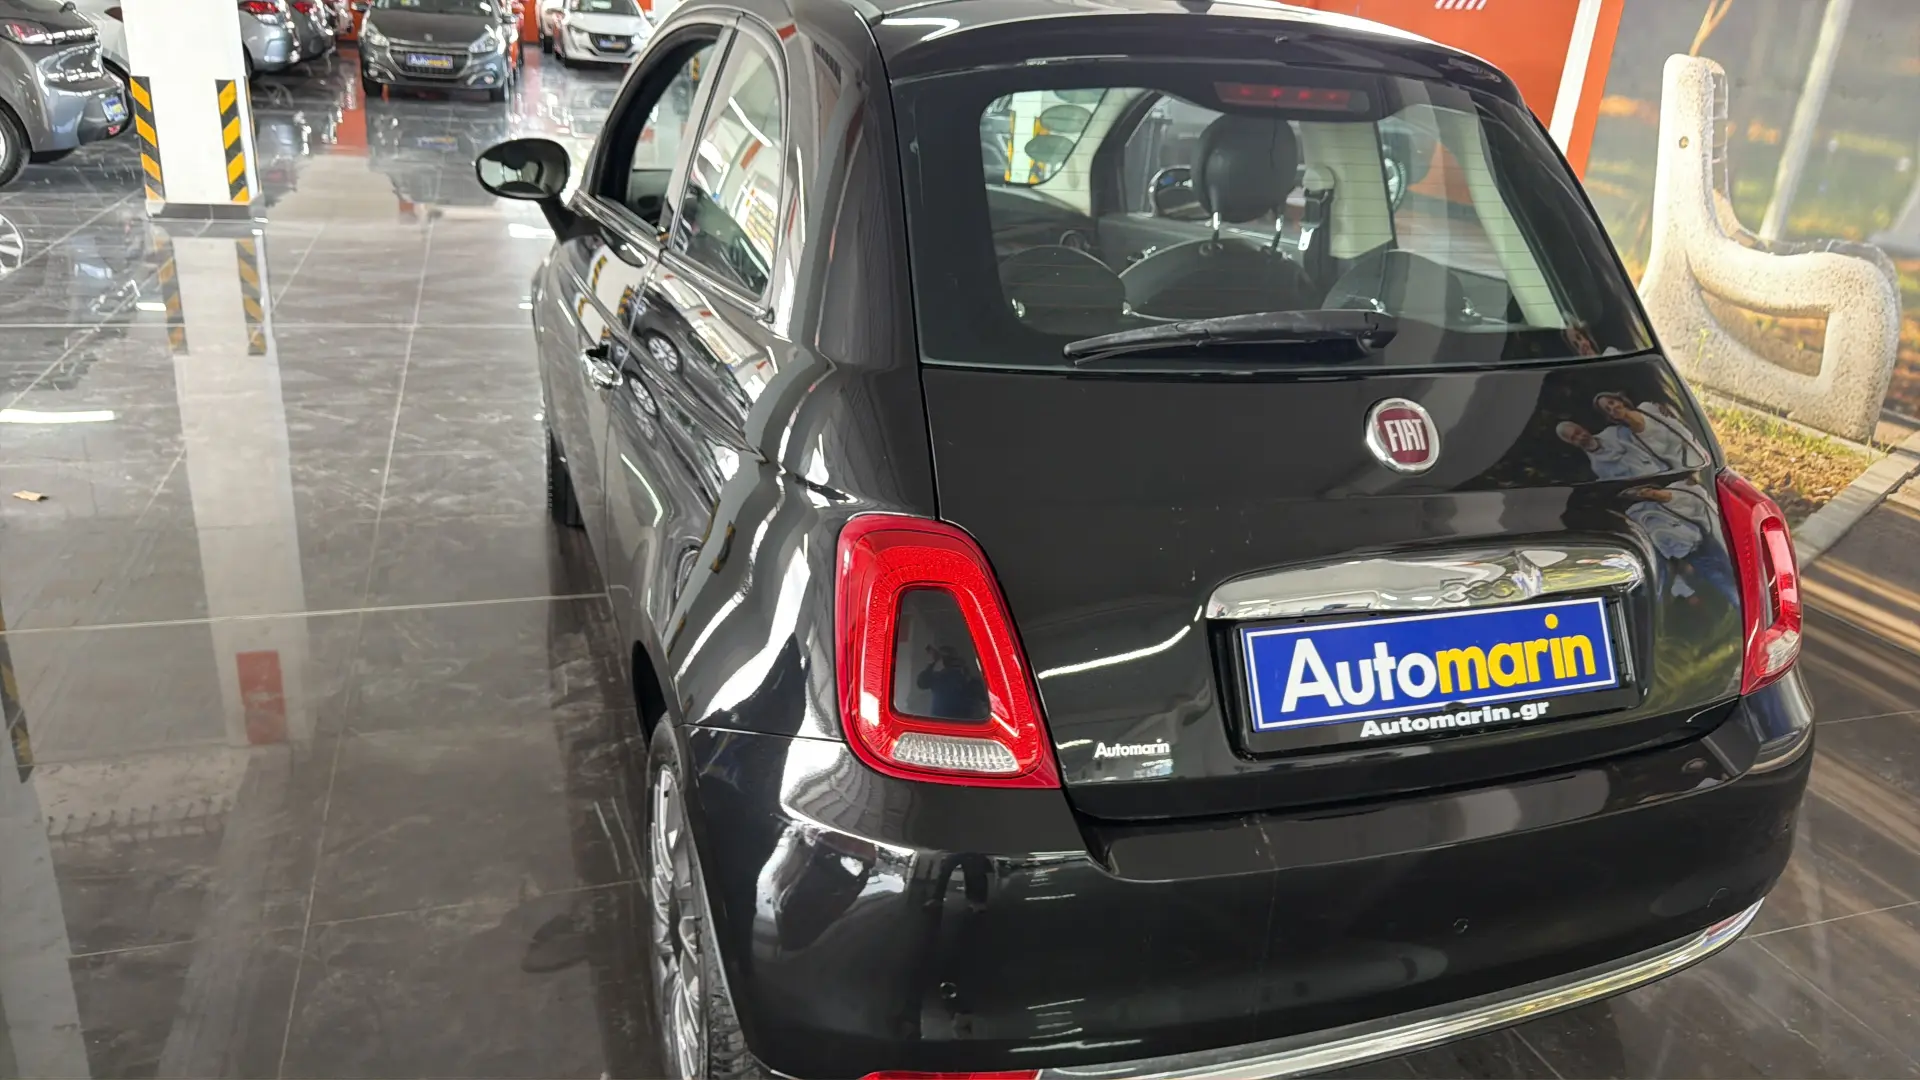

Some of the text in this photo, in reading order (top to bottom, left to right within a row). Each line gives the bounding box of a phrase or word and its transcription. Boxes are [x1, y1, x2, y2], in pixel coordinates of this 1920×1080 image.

[1384, 419, 1426, 452] FIAT
[1440, 579, 1515, 603] 500
[1281, 613, 1596, 713] Automarin
[1360, 702, 1549, 738] Automarin.gr
[1093, 738, 1170, 759] Automarin
